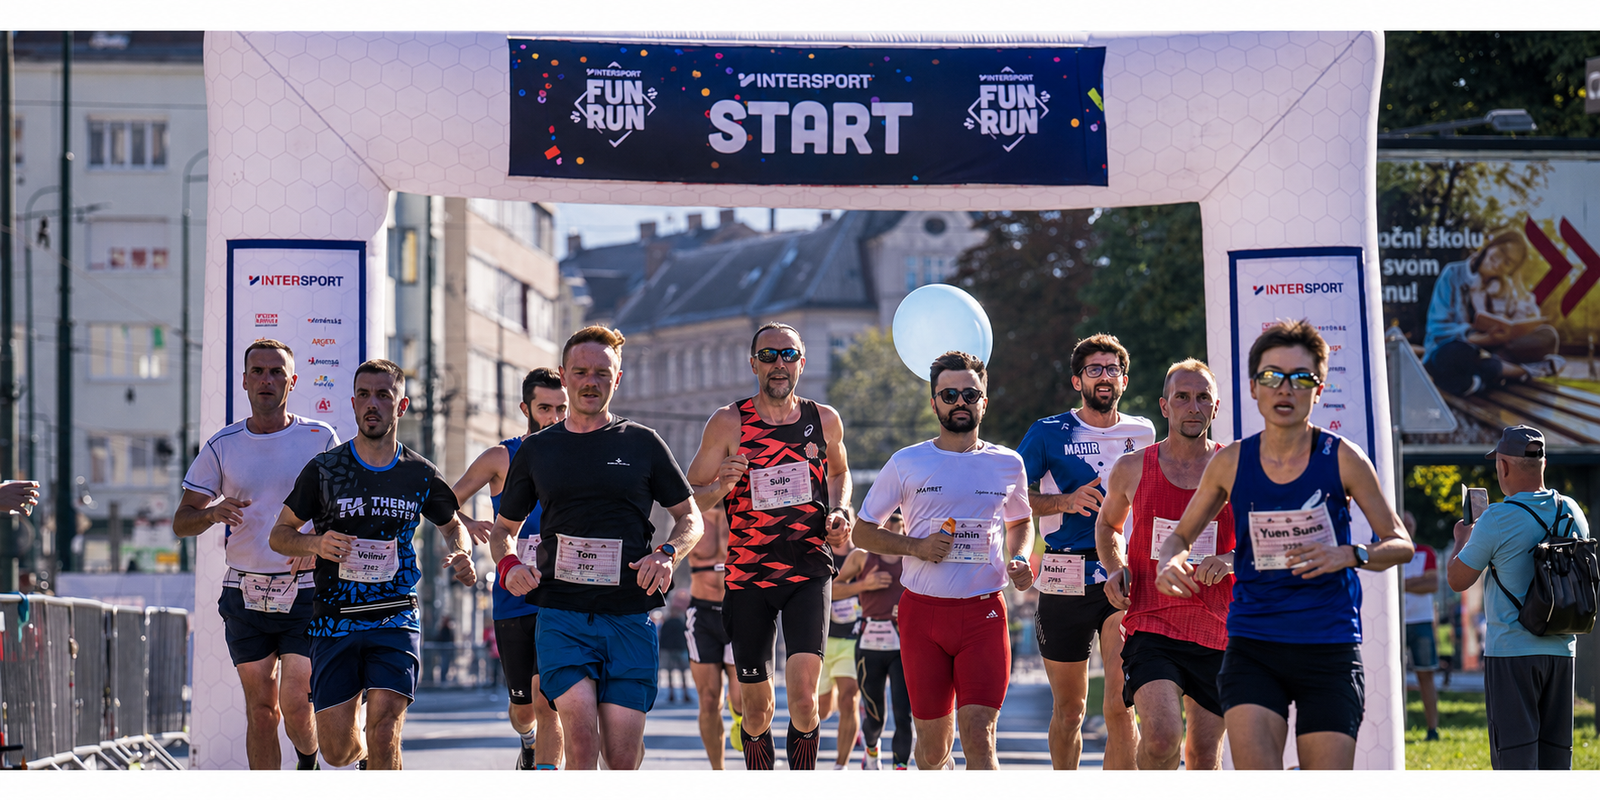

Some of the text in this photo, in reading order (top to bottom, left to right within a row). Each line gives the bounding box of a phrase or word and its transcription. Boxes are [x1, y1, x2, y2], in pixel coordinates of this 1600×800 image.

[594, 69, 642, 77] INTERSPORT
[757, 73, 872, 89] INTERSPORT
[586, 79, 644, 105] FUN
[980, 84, 1036, 110] FUN
[586, 104, 645, 131] RUN
[980, 109, 1038, 136] RUN
[708, 100, 913, 154] START
[1427, 226, 1484, 249] školu
[1383, 258, 1440, 276] svom
[261, 275, 344, 287] INTERSPORT
[1266, 282, 1344, 295] INTERSPORT
[1382, 281, 1419, 303] nu!
[1064, 443, 1099, 455] MAHIR
[1260, 527, 1290, 539] Yuen
[358, 551, 387, 560] Velimir
[576, 550, 597, 559] Tom
[1044, 565, 1067, 573] Mahir
